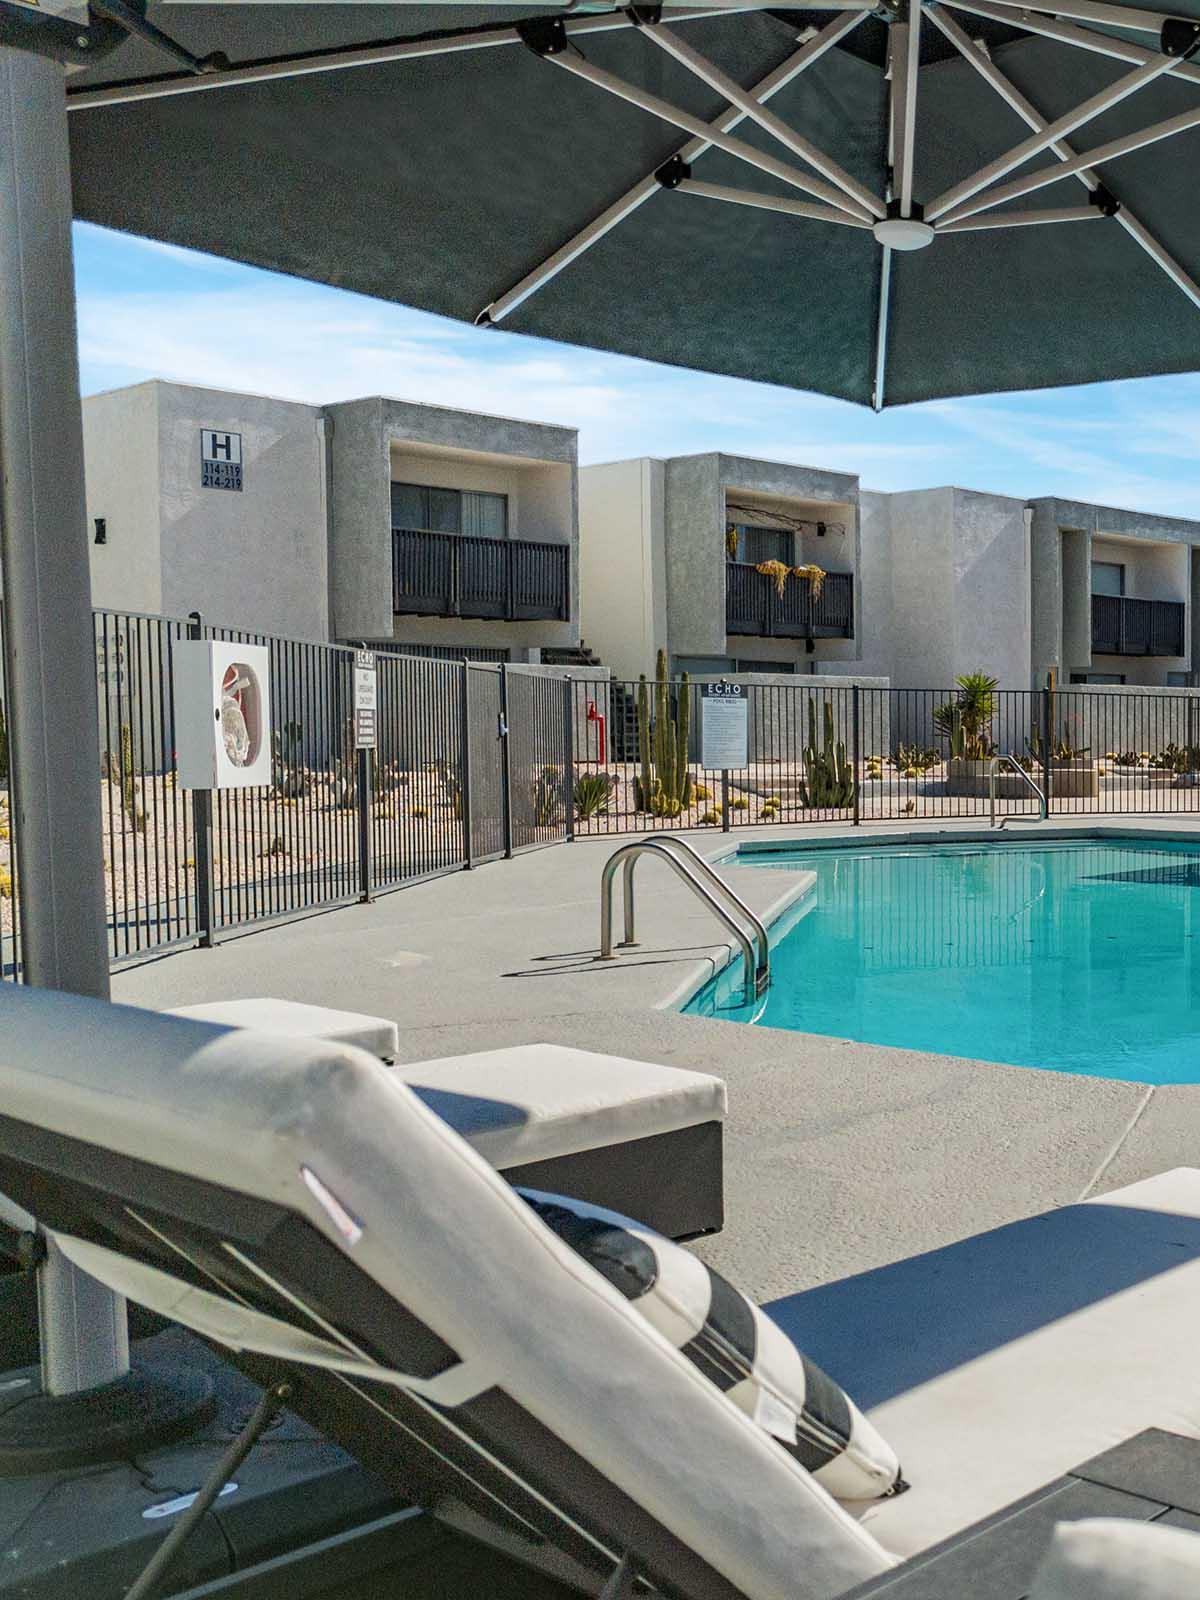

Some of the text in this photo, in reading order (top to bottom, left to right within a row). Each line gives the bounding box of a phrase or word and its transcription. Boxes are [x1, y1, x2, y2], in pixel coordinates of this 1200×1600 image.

[211, 433, 231, 461] H
[204, 462, 241, 477] 114-119
[202, 474, 241, 489] 214-219
[708, 683, 741, 694] ECHO
